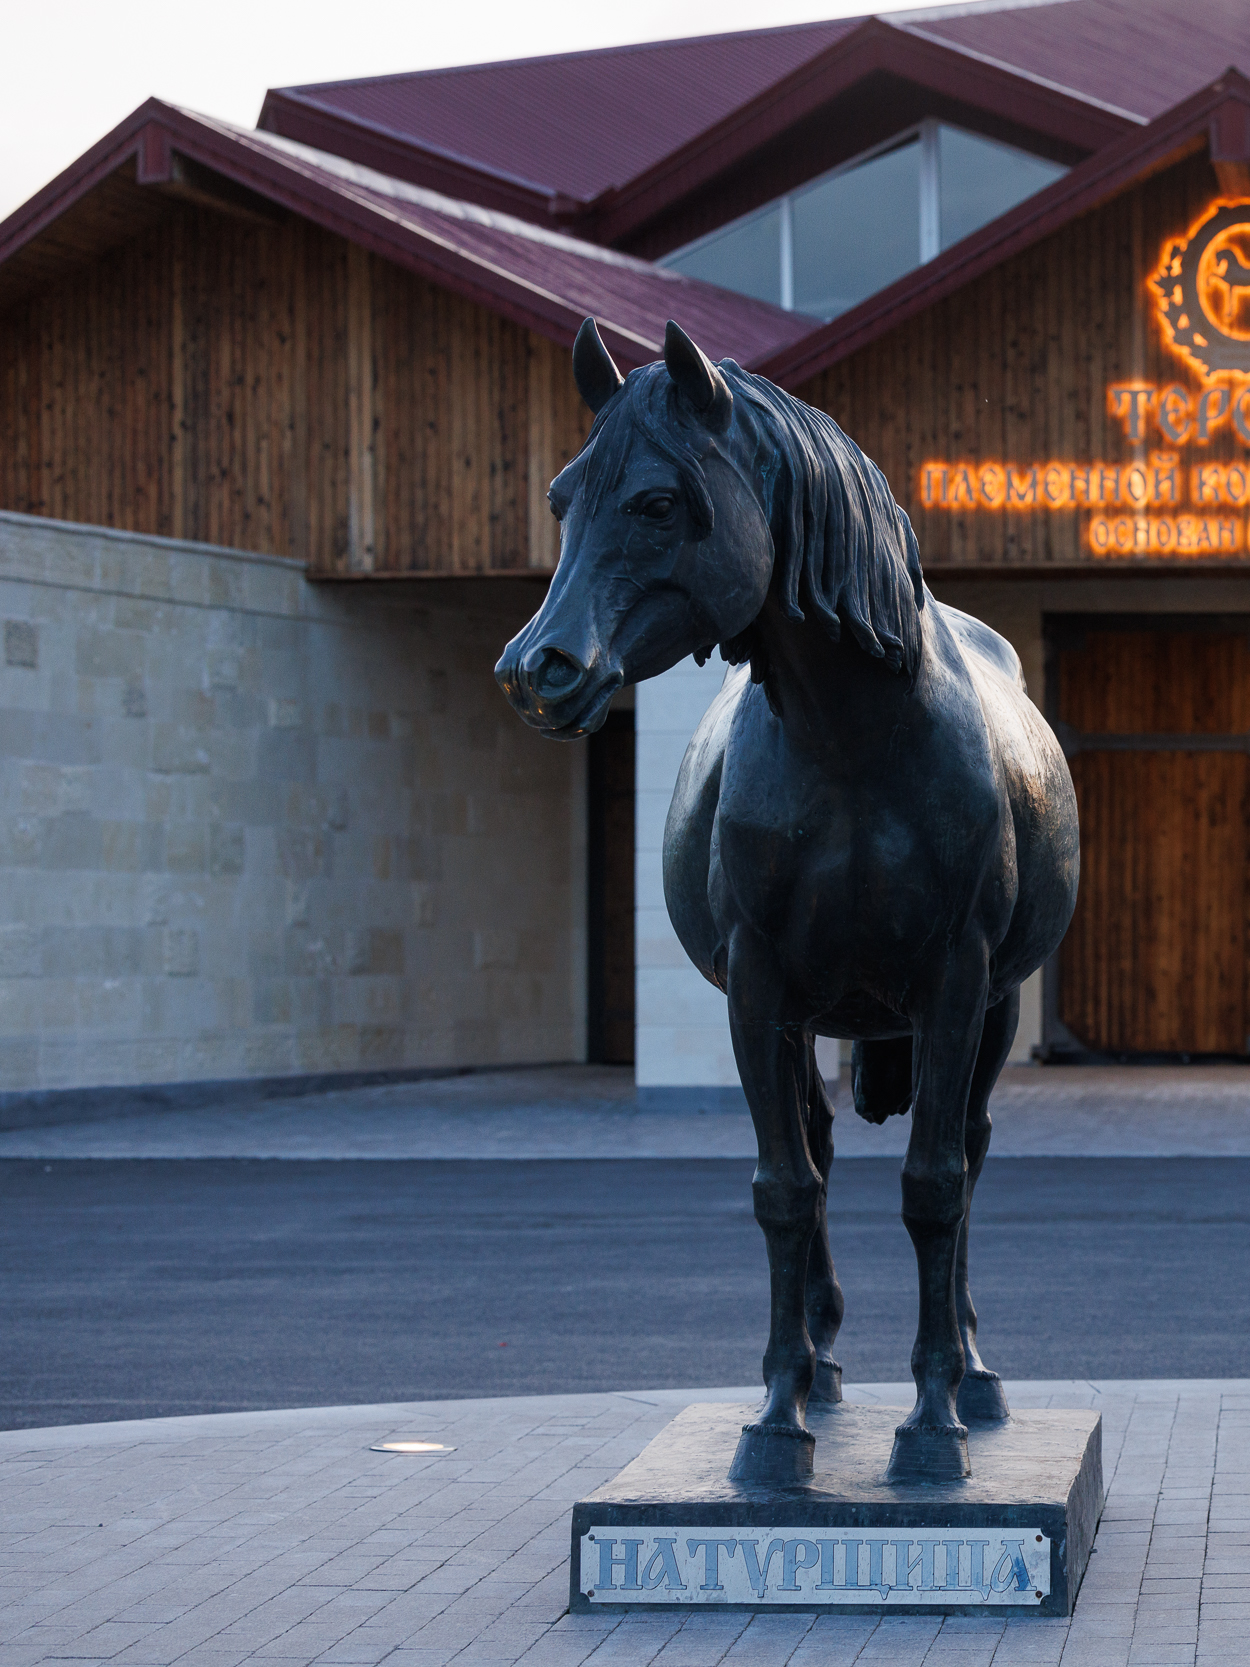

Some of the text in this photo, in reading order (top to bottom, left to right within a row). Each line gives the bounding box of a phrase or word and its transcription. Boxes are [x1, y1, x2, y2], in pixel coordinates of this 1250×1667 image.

[925, 455, 1176, 503] ПЛЕМЕННОЙ
[1093, 518, 1237, 548] ОСНОВАН
[593, 1537, 1037, 1600] НАТУРЩИЦА
